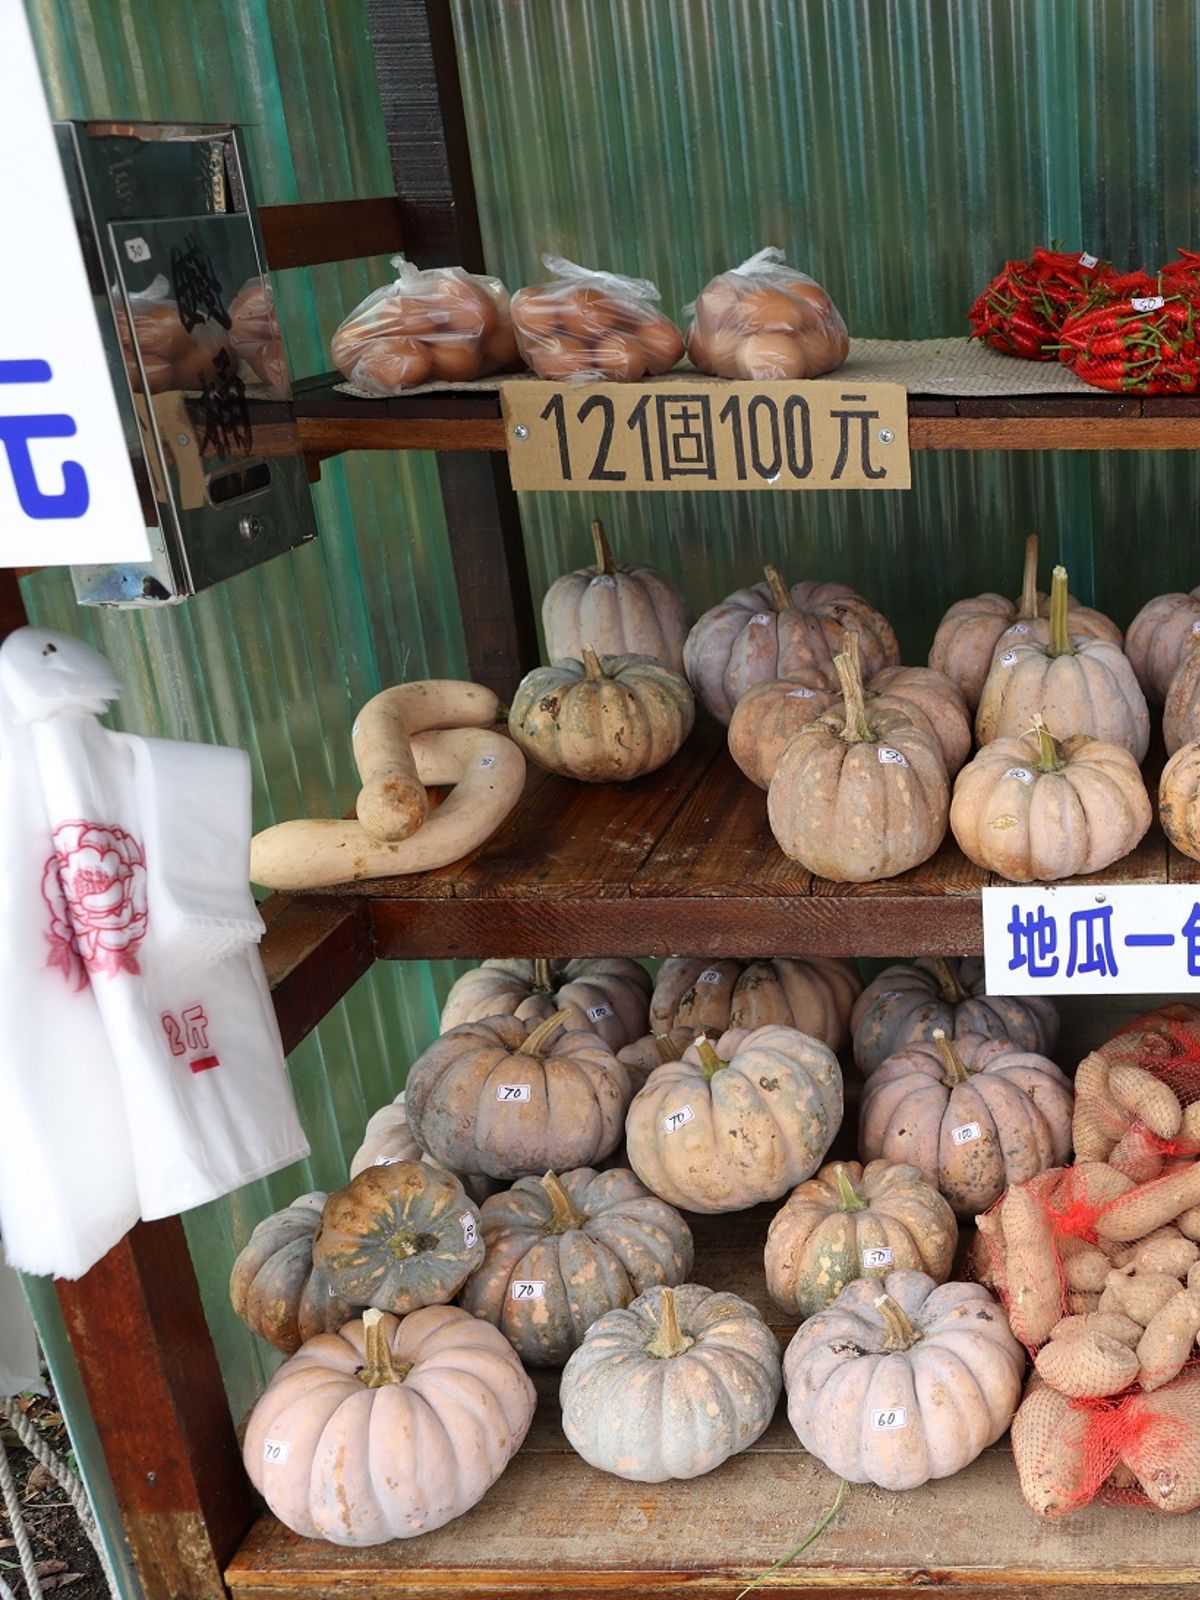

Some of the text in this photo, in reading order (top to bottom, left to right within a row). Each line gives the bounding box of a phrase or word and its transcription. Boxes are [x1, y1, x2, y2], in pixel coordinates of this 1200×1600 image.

[590, 1006, 606, 1019] 100
[503, 1087, 522, 1100] 70
[669, 1112, 685, 1131] 70
[957, 1127, 973, 1140] 100
[517, 1284, 534, 1299] 70
[878, 1411, 896, 1427] 60
[267, 1444, 281, 1459] 70
